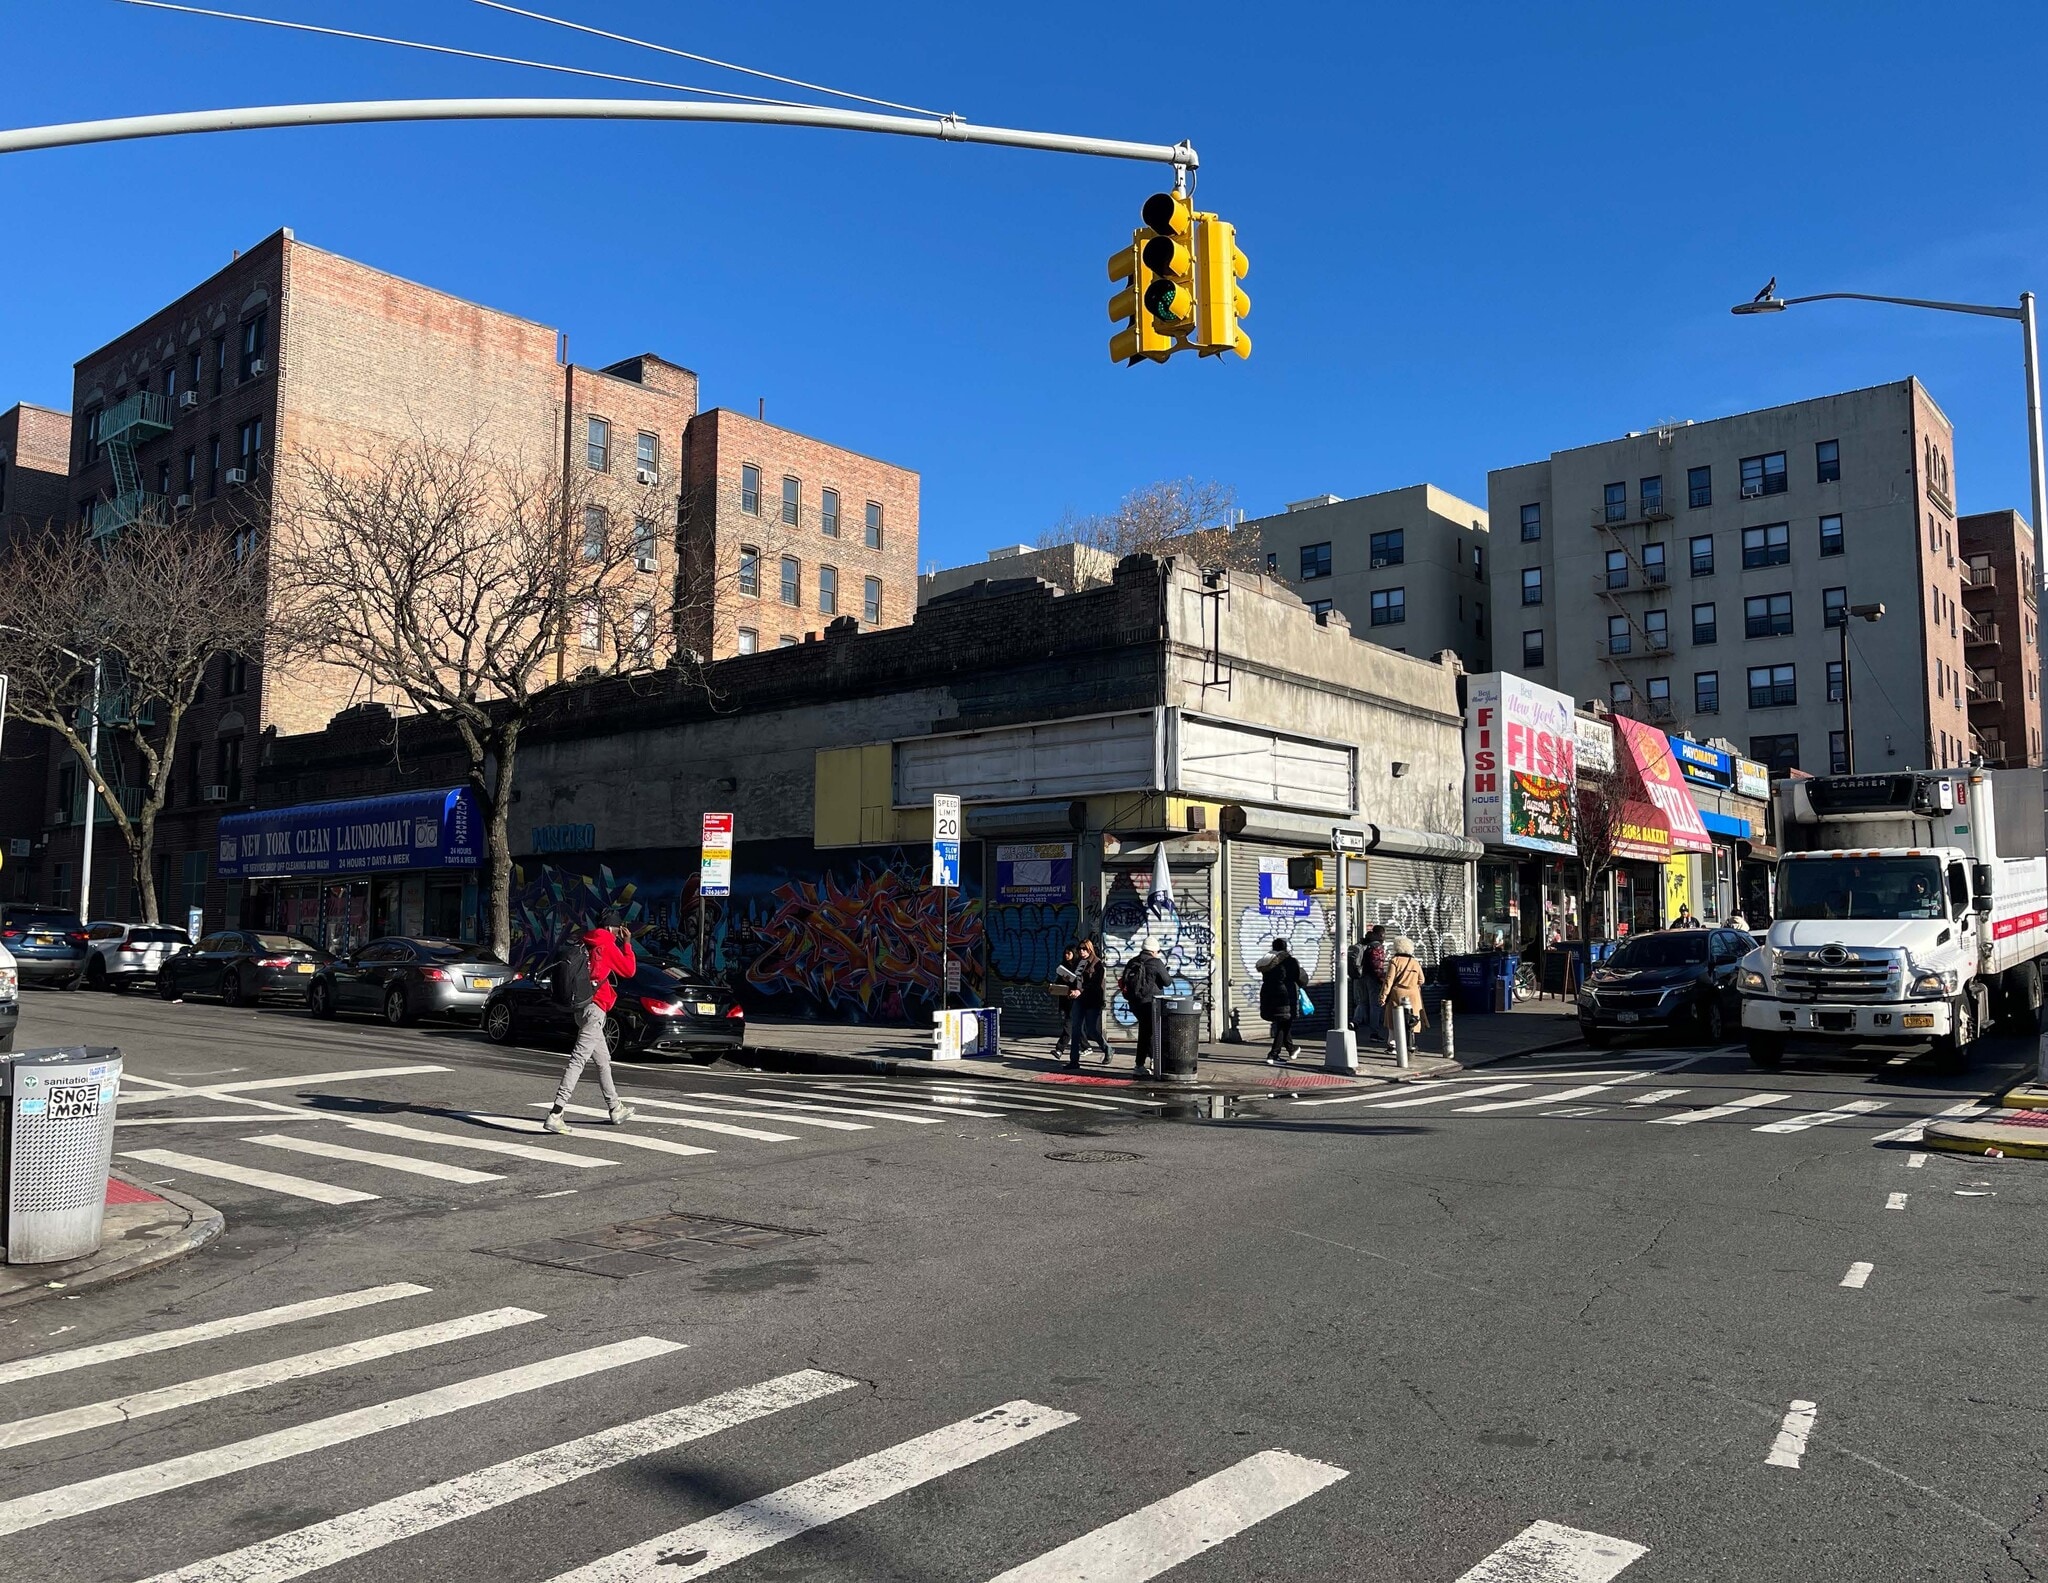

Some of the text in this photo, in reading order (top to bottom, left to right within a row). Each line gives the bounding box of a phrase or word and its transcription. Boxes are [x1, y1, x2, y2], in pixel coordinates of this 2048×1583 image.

[1508, 694, 1556, 725] New York
[1475, 708, 1496, 792] FISH
[1507, 721, 1574, 783] FISH
[1682, 744, 1718, 767] PAYOMATIC
[1832, 779, 1887, 789] CARRIER
[938, 800, 958, 808] SPEED
[1472, 796, 1500, 804] HOUSE
[1645, 780, 1708, 836] PIZZA
[455, 796, 468, 844] LAUNDROMAT
[938, 818, 957, 835] 20
[241, 820, 411, 857] NEW YORK CLEAN LAUNDROMAT
[1471, 826, 1501, 834] CHICKEN
[1642, 826, 1668, 845] BAKERY
[450, 847, 472, 855] 24 HOURS
[944, 853, 958, 861] ZONE
[307, 860, 316, 870] AND
[339, 853, 410, 868] 24 HOURS 7 DAYS A WEEK
